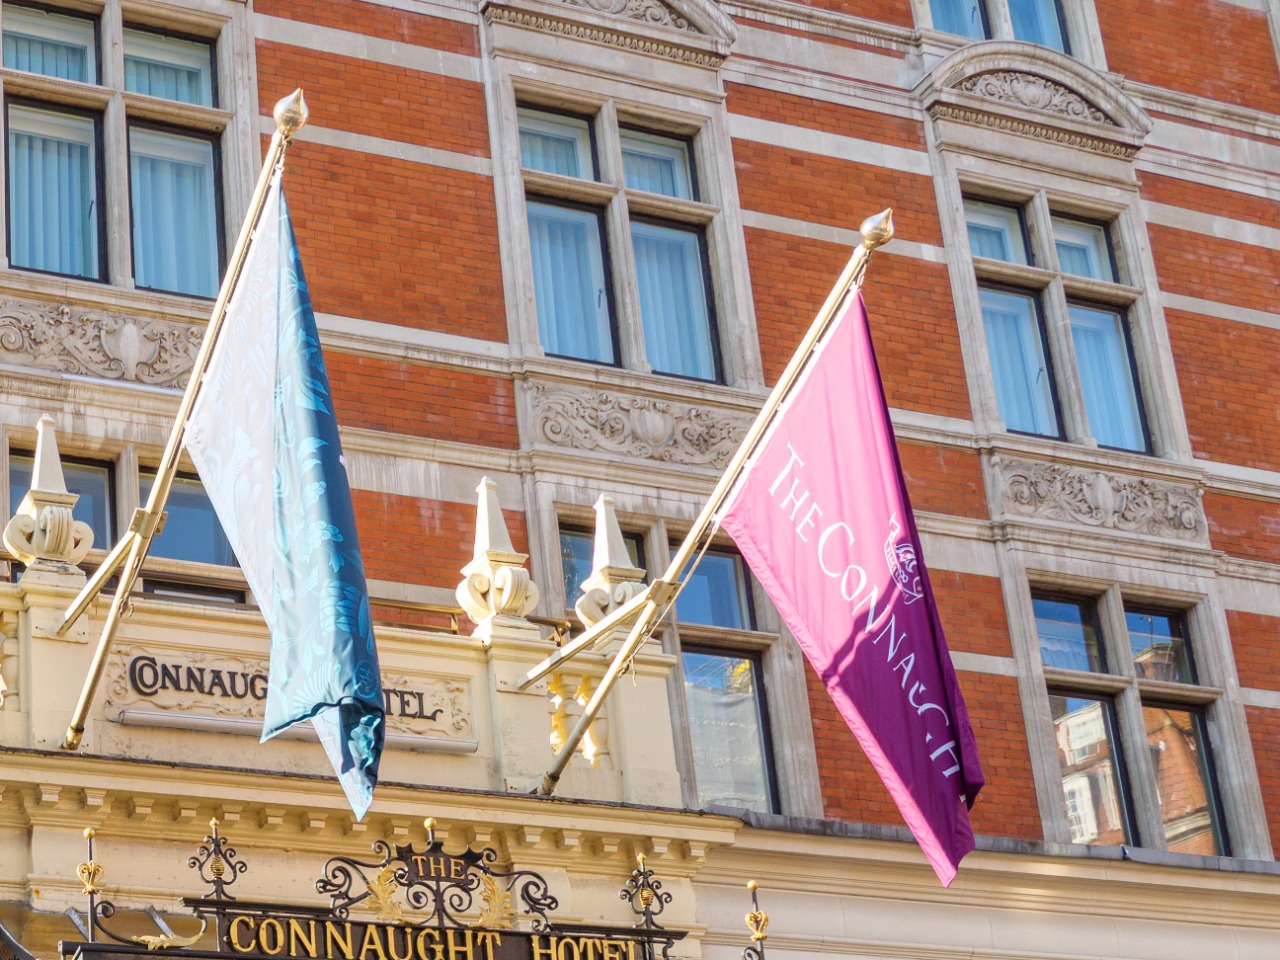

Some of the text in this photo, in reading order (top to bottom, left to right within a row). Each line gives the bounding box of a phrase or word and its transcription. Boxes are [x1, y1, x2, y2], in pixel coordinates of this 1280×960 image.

[768, 441, 823, 544] THE
[128, 655, 444, 721] CONNAUG TEL
[411, 855, 467, 880] THE
